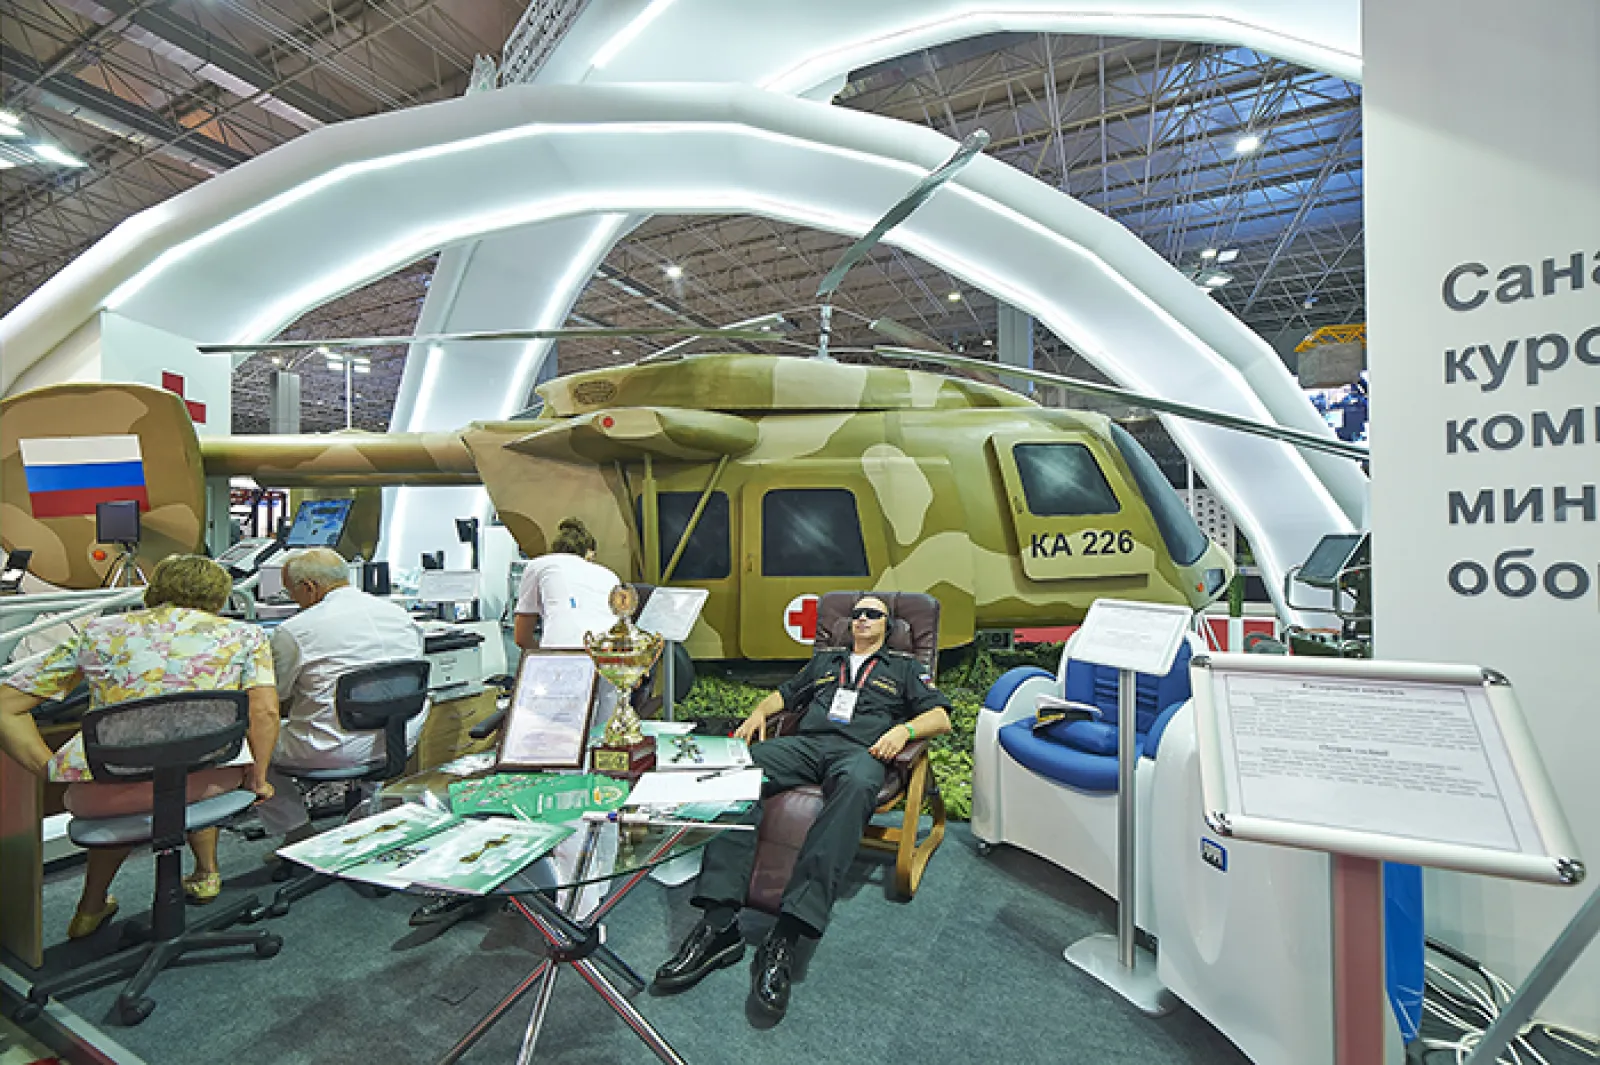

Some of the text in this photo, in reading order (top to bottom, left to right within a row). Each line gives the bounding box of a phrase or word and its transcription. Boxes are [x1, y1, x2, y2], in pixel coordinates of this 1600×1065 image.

[1441, 250, 1600, 312] Сан
[1446, 405, 1600, 454] ком
[1031, 529, 1134, 558] КА 226
[1448, 548, 1600, 600] обо
